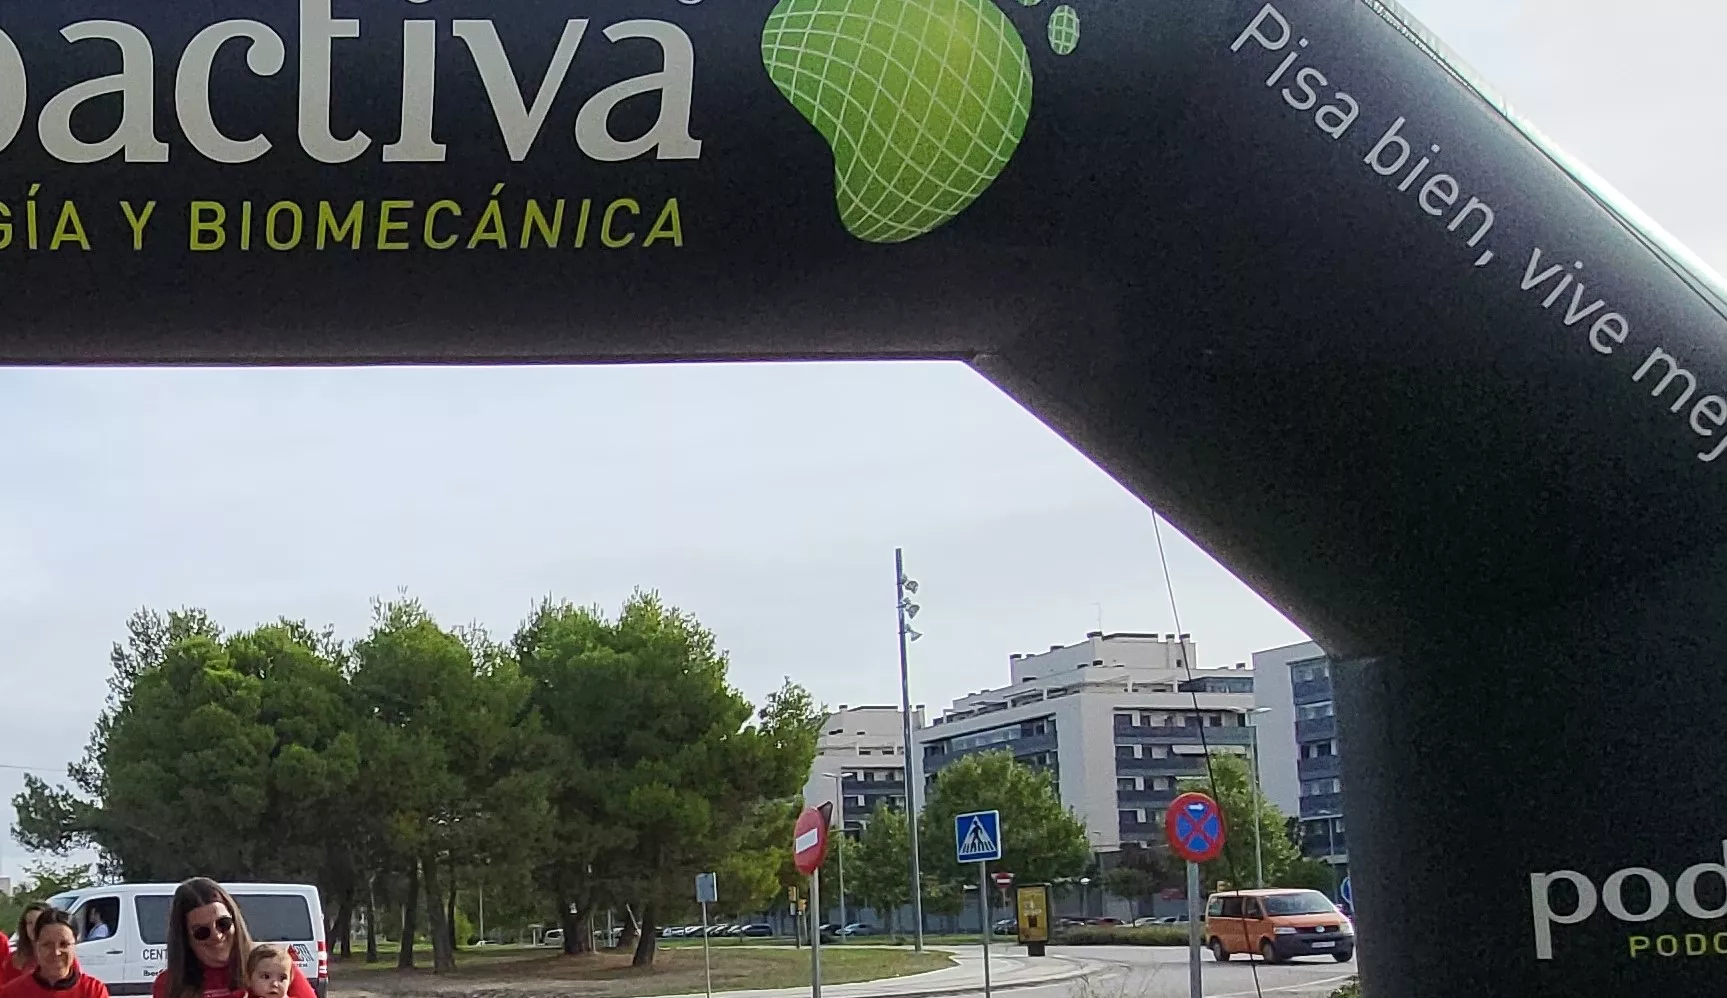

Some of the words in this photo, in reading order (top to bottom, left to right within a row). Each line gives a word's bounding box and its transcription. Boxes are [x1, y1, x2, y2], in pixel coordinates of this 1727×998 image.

[119, 200, 157, 250] Y
[189, 183, 684, 251] BIOMECÁNICA
[1230, 2, 1360, 139] Pisa
[1363, 116, 1494, 266] bien,
[1521, 248, 1630, 354] vive
